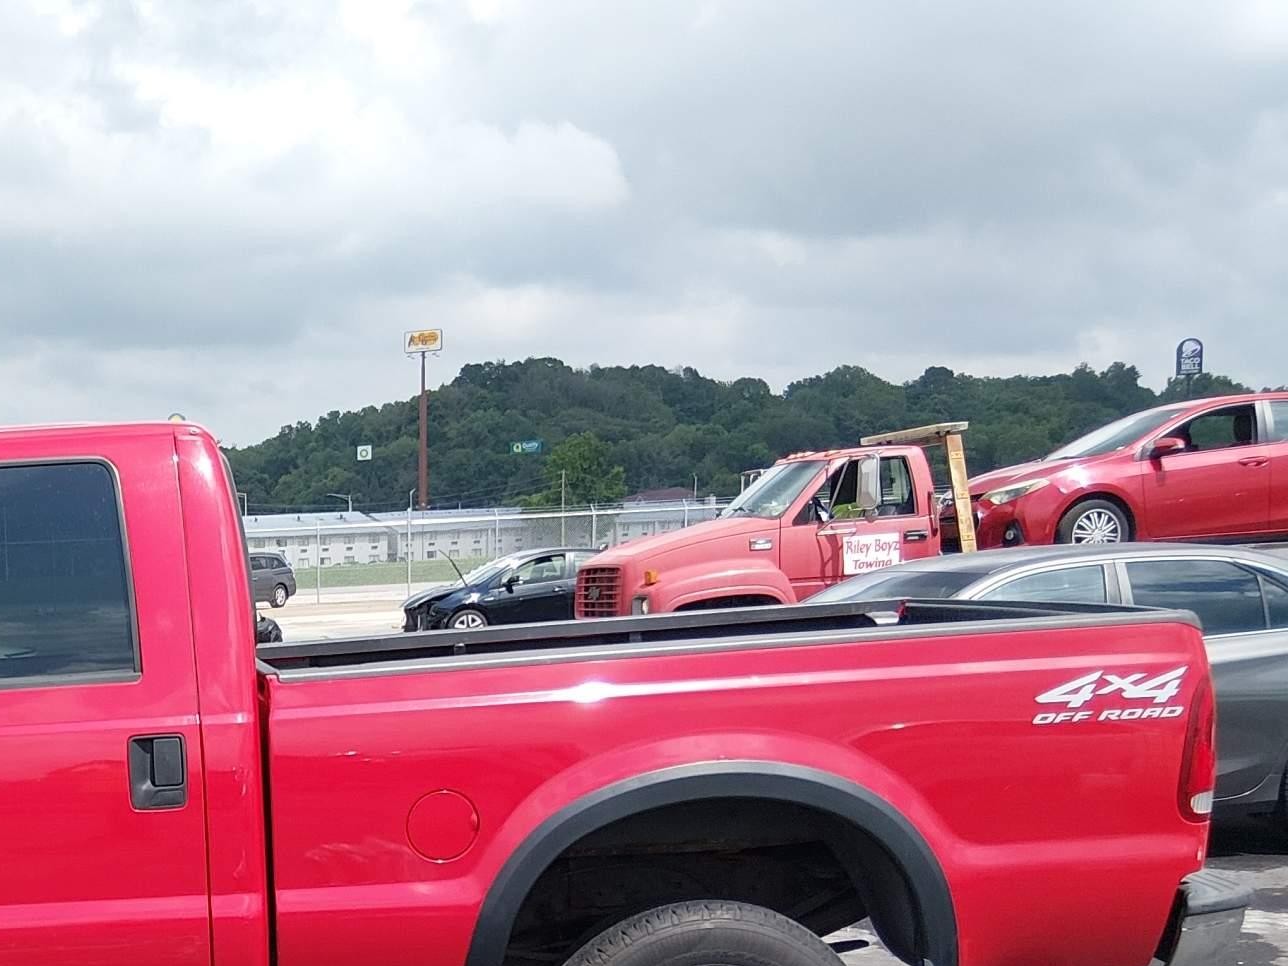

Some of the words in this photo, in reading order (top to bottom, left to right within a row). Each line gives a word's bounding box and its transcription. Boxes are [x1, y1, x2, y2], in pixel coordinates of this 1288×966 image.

[846, 541, 871, 557] Riley
[874, 538, 900, 555] Boyz
[1032, 710, 1095, 725] OFF
[1097, 706, 1185, 721] ROAD
